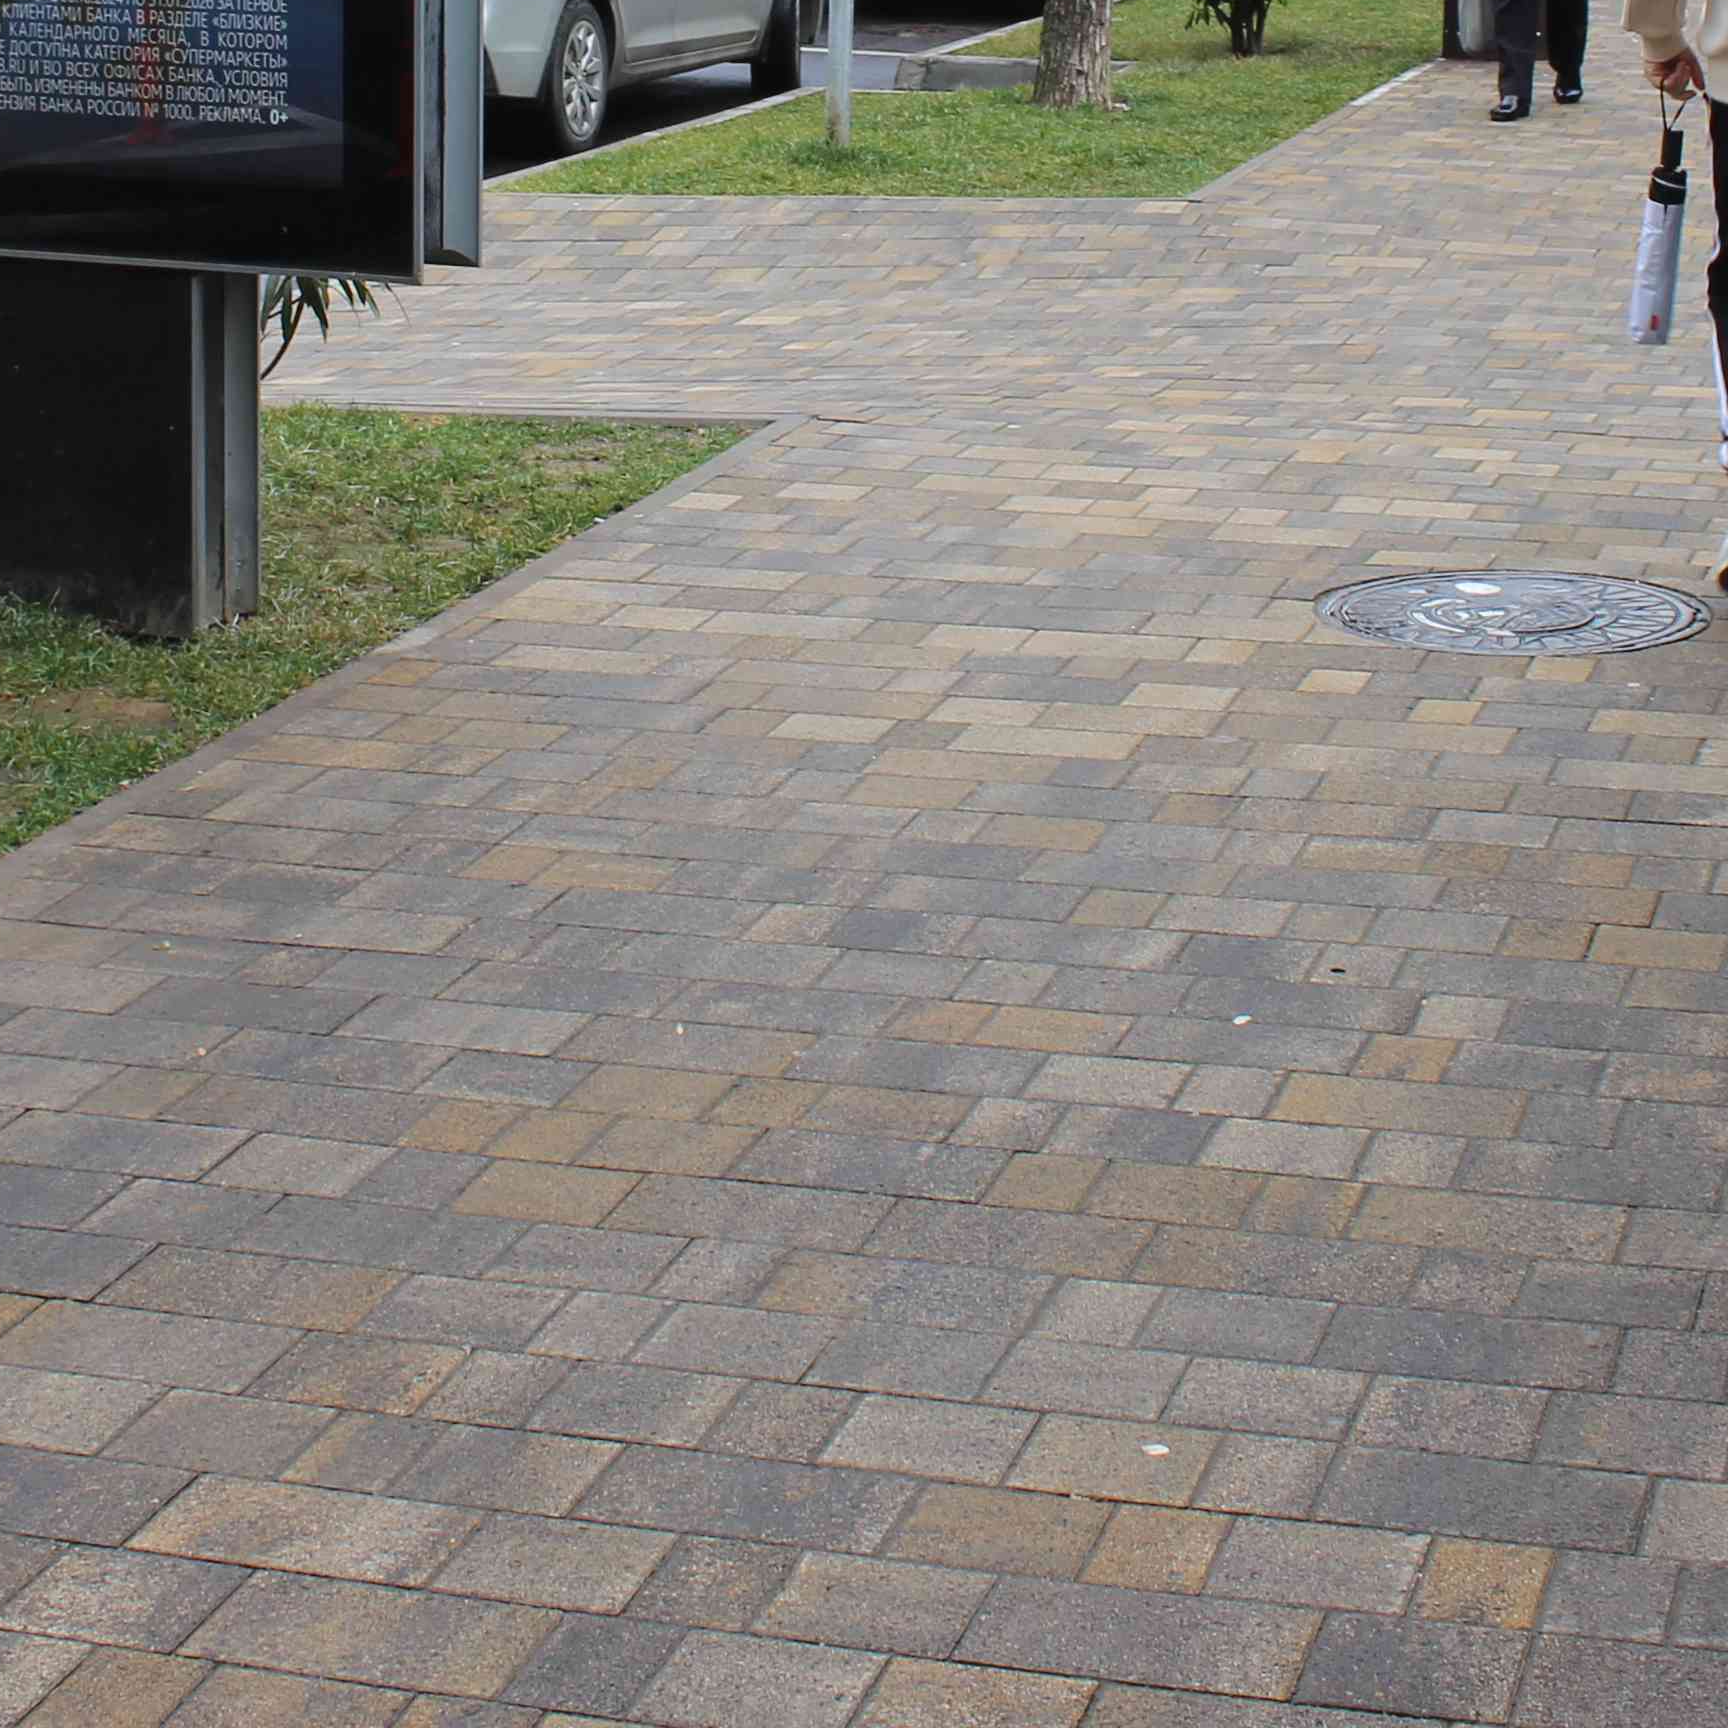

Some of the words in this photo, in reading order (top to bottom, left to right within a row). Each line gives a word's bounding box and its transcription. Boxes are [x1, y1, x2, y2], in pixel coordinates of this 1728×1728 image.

[2, 4, 82, 22] КЛИЕНТАМИ
[86, 8, 132, 24] БАНКА
[136, 10, 144, 25] В
[149, 10, 207, 28] РАЗДЕЛЕ
[211, 13, 287, 31] «БЛИЗКИЕ»
[9, 22, 119, 42] КАЛЕНДАРНОГО
[127, 27, 191, 45] МЕСЯЦА,
[200, 30, 209, 46] В
[217, 31, 287, 49] КОТОРОМ
[8, 41, 81, 59] ДОСТУПНА
[83, 44, 160, 63] КАТЕГОРИЯ
[163, 48, 287, 68] «СУПЕРМАРКЕТЫ»
[29, 59, 39, 75] И
[43, 60, 62, 76] ВО
[65, 61, 99, 78] ВСЕХ
[102, 63, 164, 81] ОФИСАХ
[223, 69, 287, 87] УСЛОВИЯ
[0, 76, 31, 94] БЫТЬ
[34, 78, 104, 97] ИЗМЕНЕНЫ
[107, 81, 162, 100] БАНКОМ
[165, 84, 173, 101] В
[176, 85, 225, 103] ЛЮБОЙ
[227, 87, 288, 106] МОМЕНТ.
[39, 96, 84, 114] БАНКА
[87, 99, 140, 117] РОССИИ
[164, 102, 193, 120] 1000.
[199, 104, 265, 123] РЕКЛАМА.
[269, 107, 288, 125] 0+
